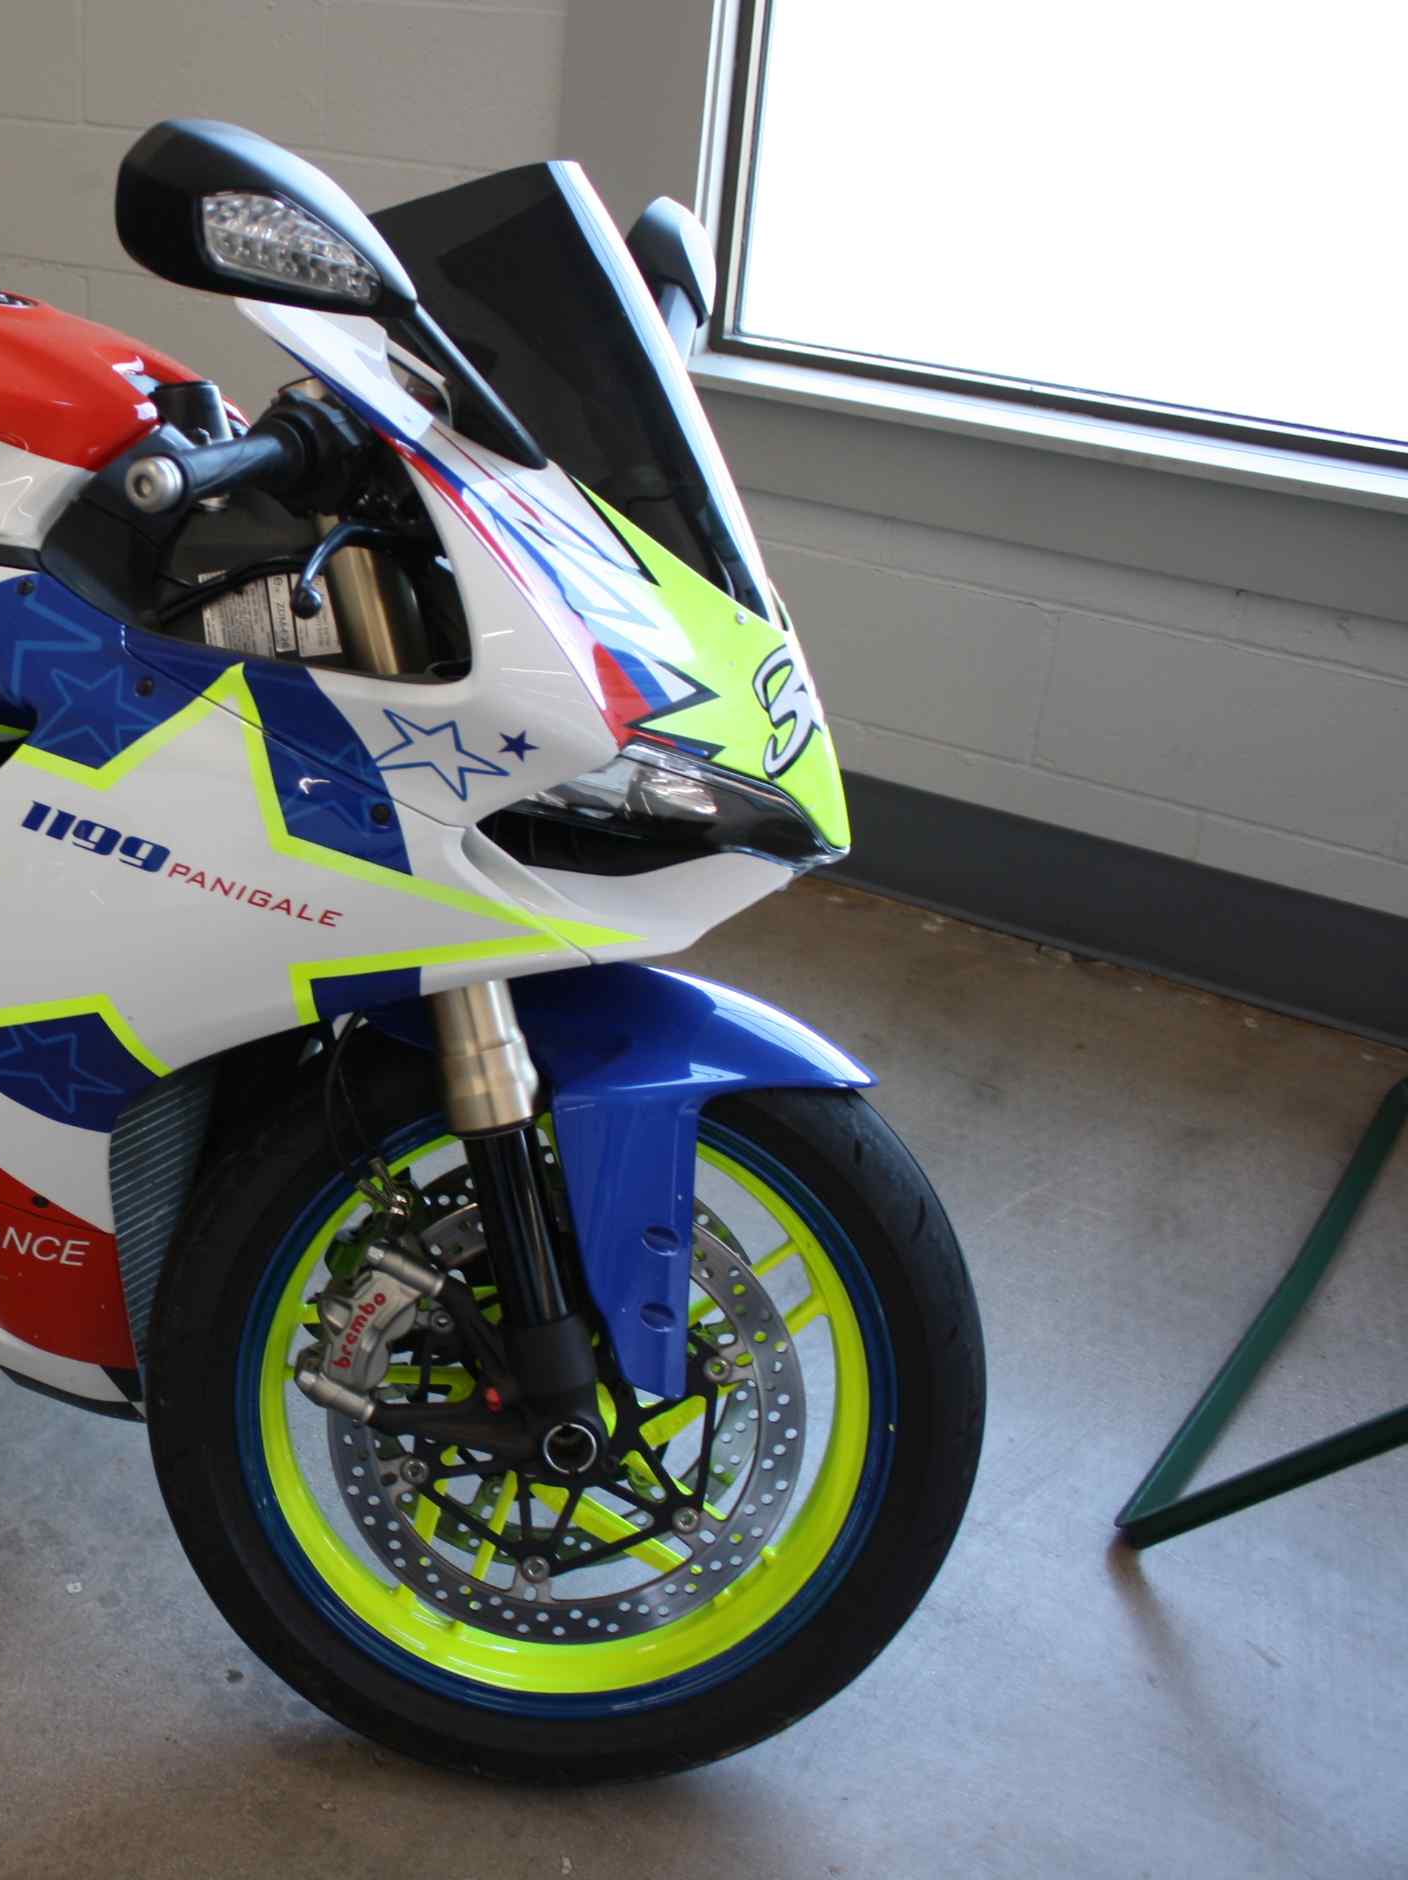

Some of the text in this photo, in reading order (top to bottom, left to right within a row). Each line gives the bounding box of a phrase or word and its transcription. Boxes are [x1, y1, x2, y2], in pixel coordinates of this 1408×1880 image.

[21, 800, 343, 927] 1199 PANIGALE
[331, 1292, 387, 1370] brembo
